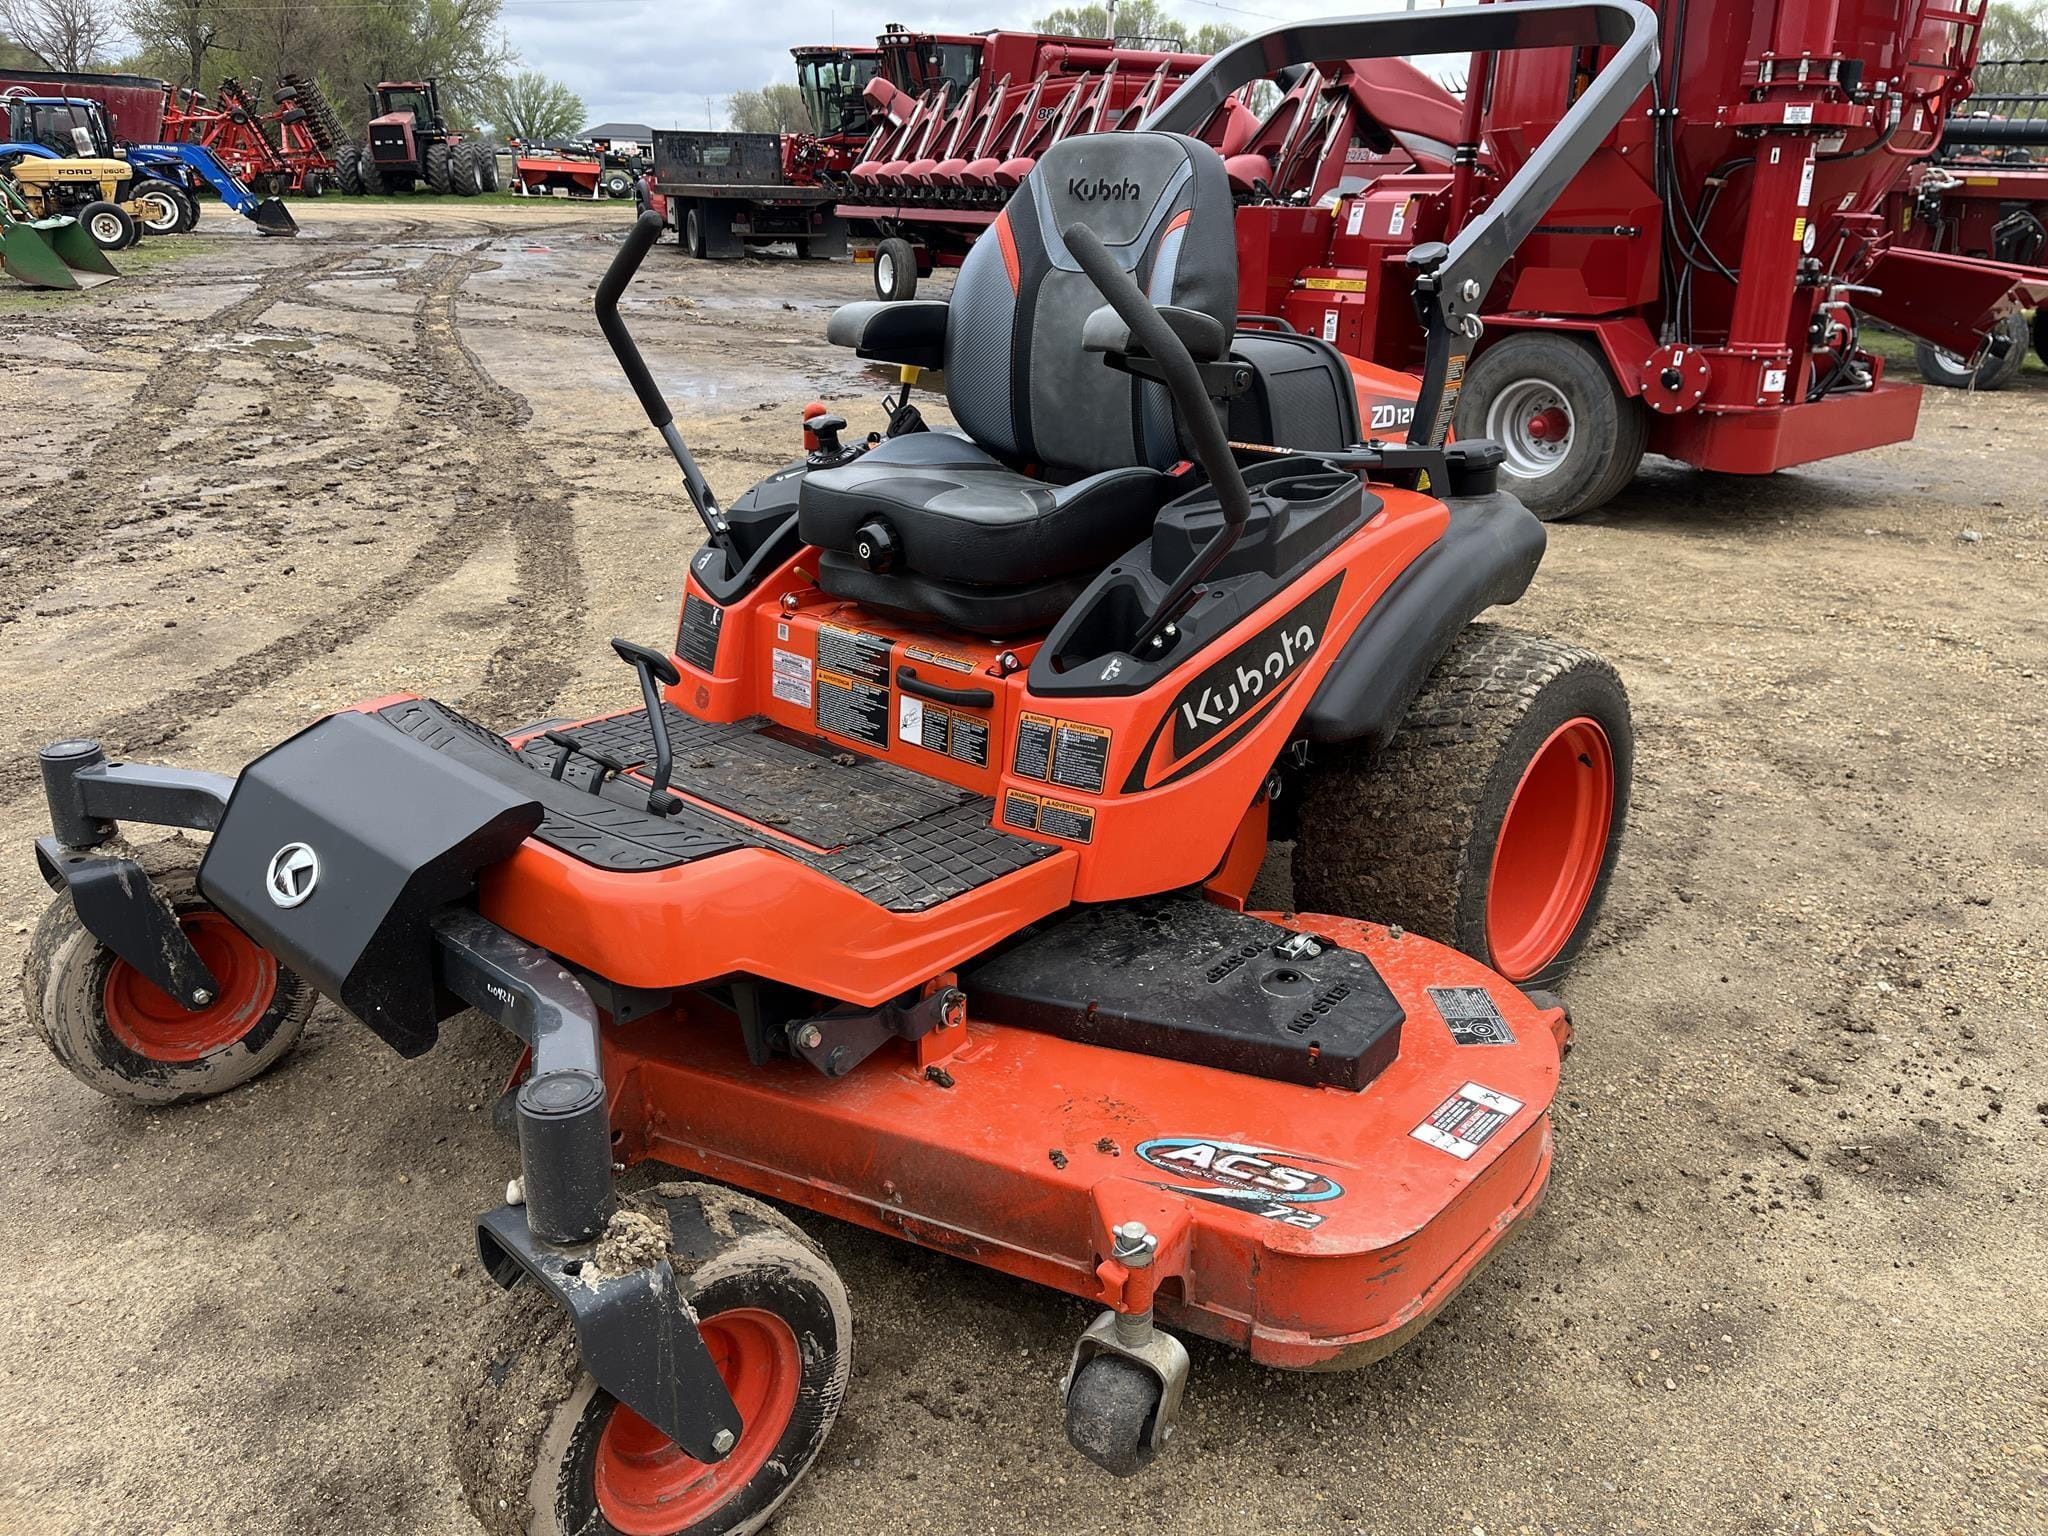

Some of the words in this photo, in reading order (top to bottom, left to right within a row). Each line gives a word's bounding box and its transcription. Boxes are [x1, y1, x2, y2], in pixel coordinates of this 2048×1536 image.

[153, 144, 179, 152] HOLLAND
[1069, 177, 1140, 201] Kubota
[1371, 405, 1395, 429] ZD
[1182, 625, 1315, 730] Kubota
[1069, 723, 1105, 735] ADVERTENCIA
[1014, 792, 1038, 802] WARNING
[1052, 801, 1090, 814] ADVERTENCIA
[1159, 1144, 1319, 1192] ACS
[1259, 1202, 1323, 1229] 72
